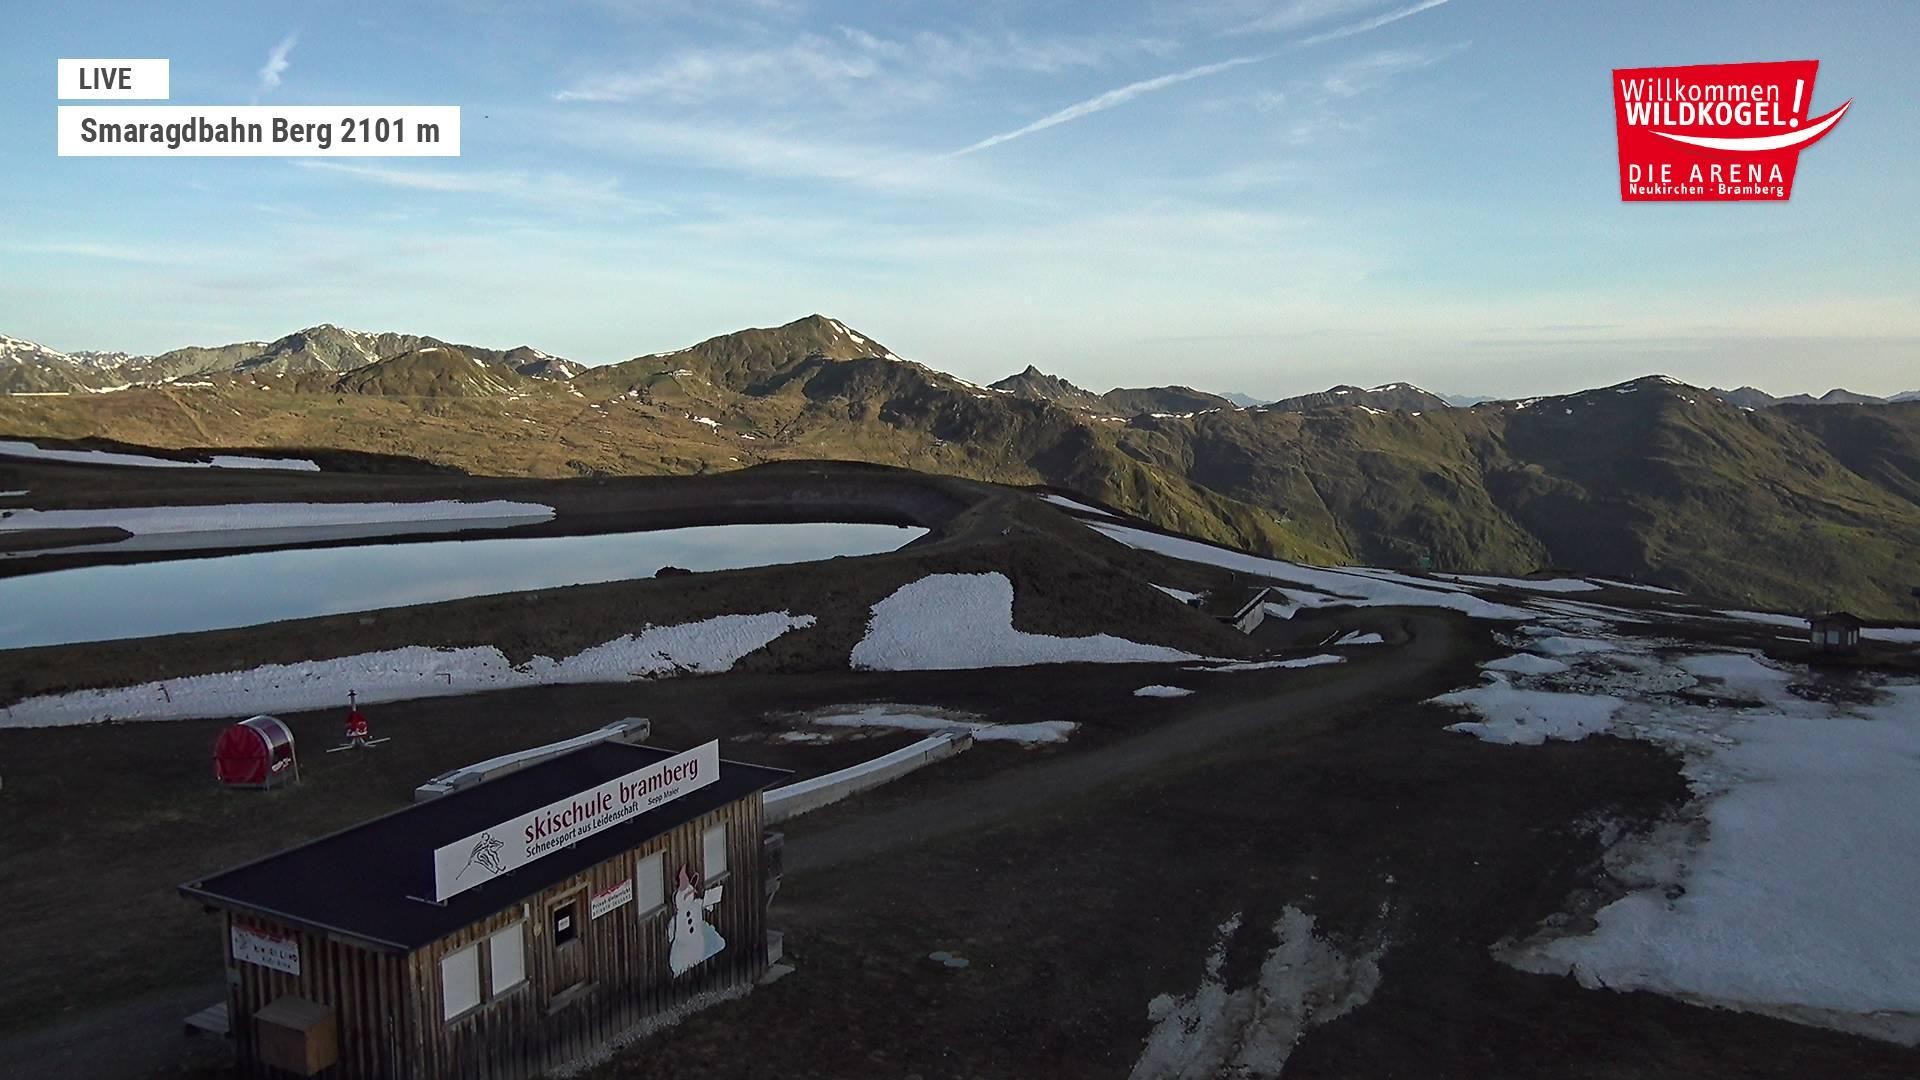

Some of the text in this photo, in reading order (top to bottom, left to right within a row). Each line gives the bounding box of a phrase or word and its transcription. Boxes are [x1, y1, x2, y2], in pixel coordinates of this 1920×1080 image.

[525, 758, 699, 844] skischule bramberg
[526, 801, 639, 858] Schneesport aus Leidenschaft
